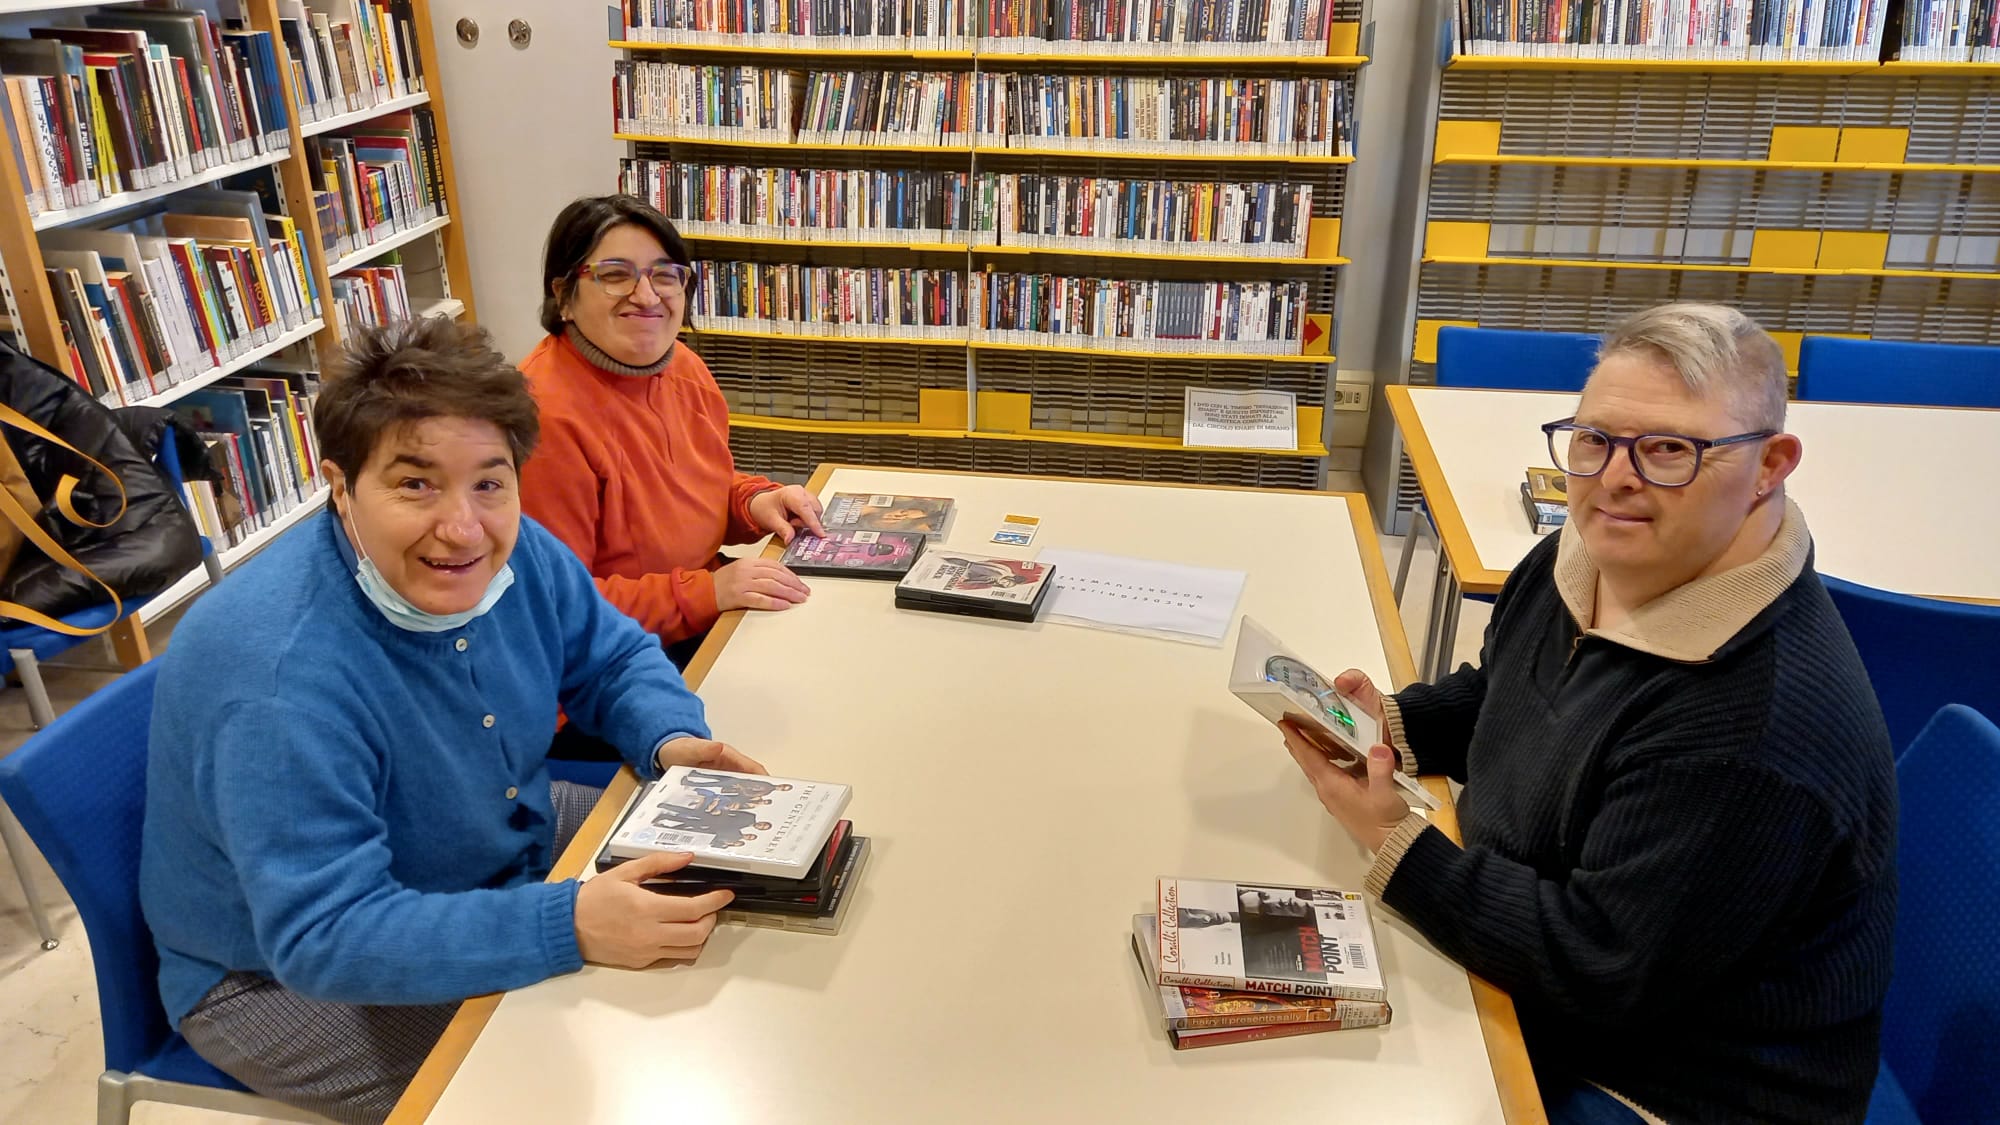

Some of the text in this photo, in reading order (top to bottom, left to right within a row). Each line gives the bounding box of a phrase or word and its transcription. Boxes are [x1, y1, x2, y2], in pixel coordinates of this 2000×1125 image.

[765, 785, 816, 853] THE GENTLEMEN
[1162, 886, 1178, 963] Coralli Collection
[1298, 925, 1324, 973] MATCH
[1320, 934, 1344, 974] POINT
[1194, 978, 1234, 988] Collection
[1245, 980, 1291, 993] MATCH
[1295, 985, 1332, 996] POINT
